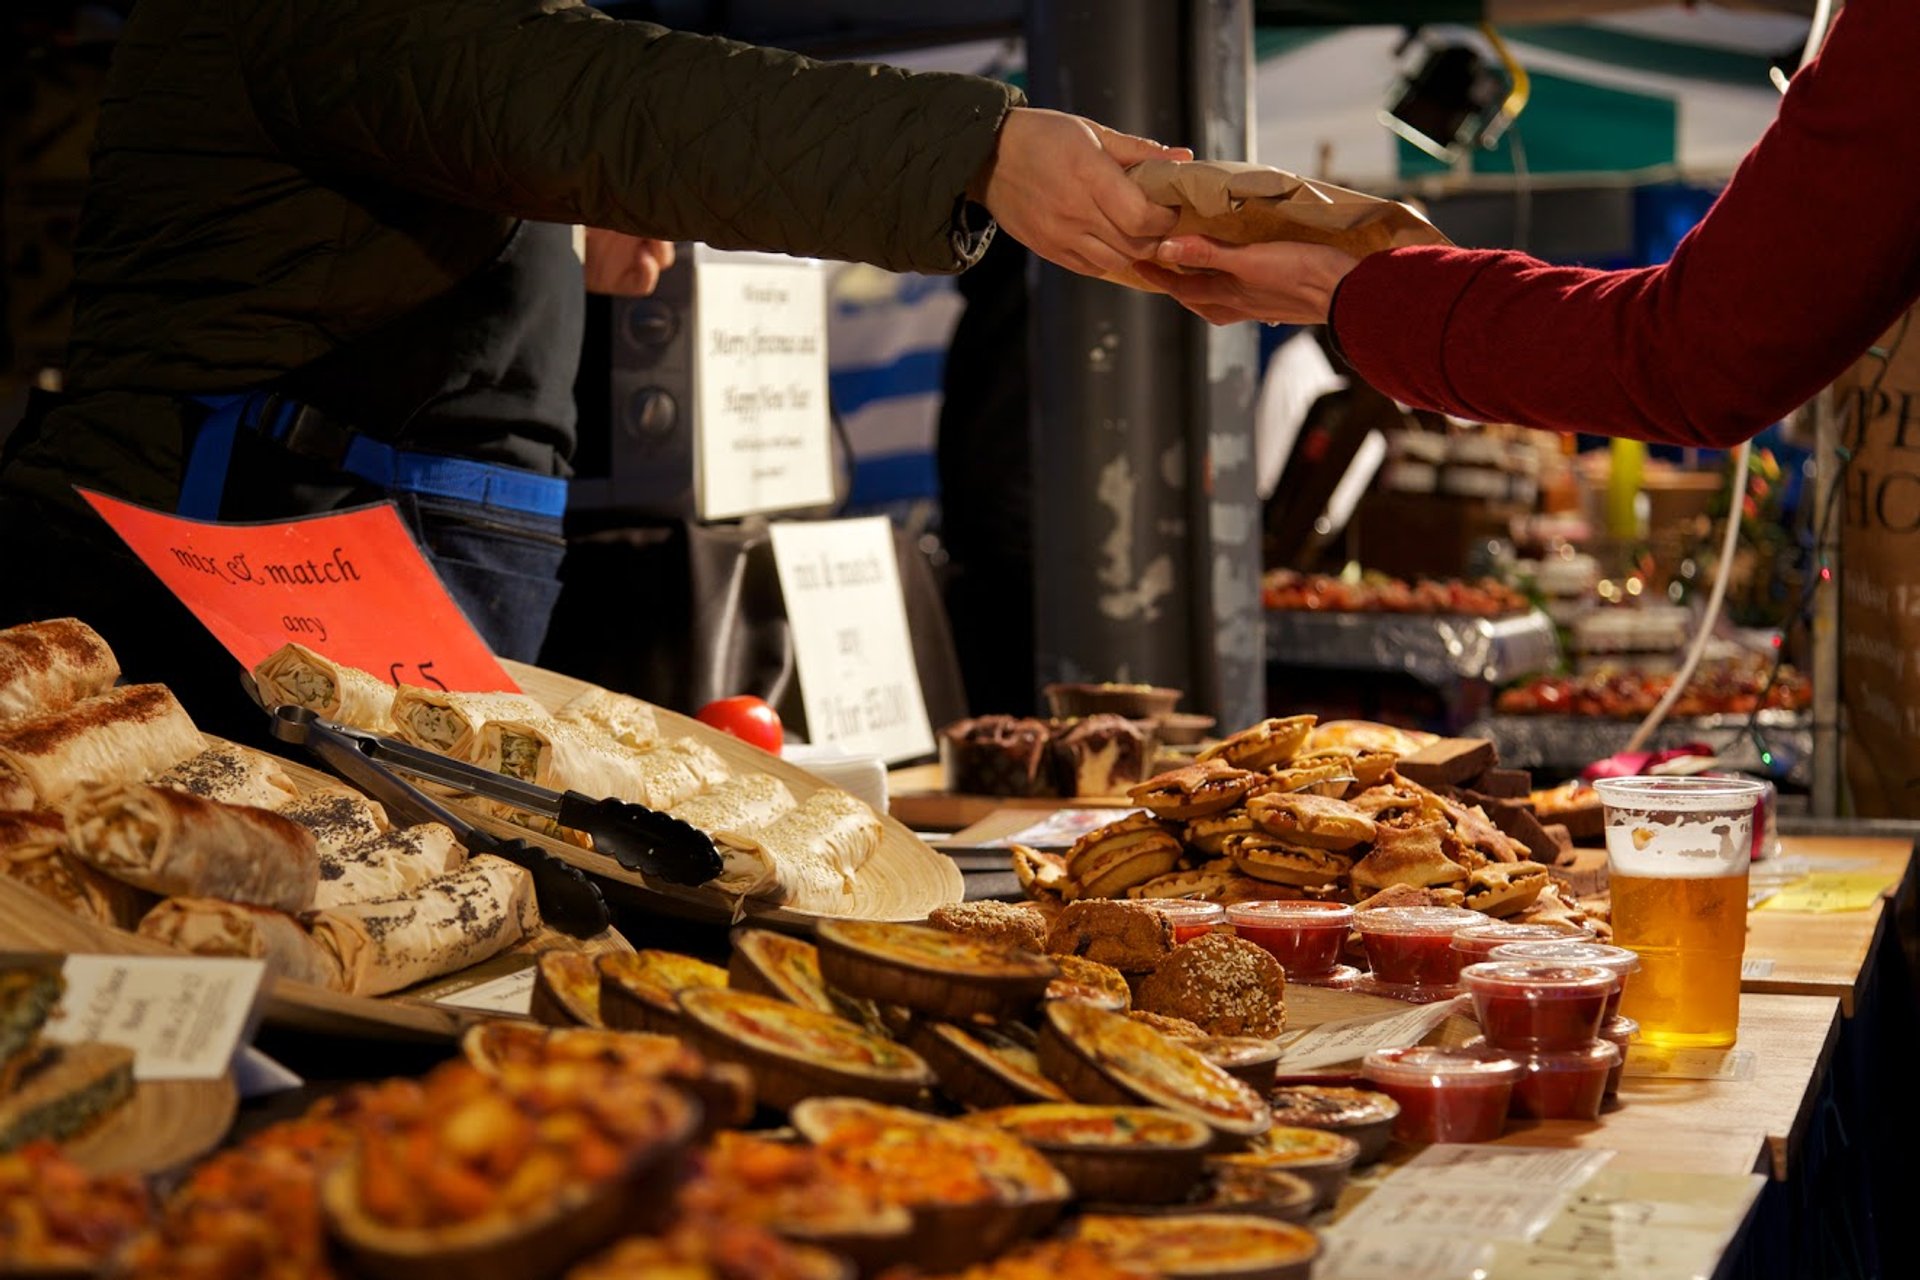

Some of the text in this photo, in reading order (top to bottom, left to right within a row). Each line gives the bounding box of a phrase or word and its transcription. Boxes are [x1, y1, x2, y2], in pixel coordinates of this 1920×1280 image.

[170, 546, 236, 585] mix
[264, 547, 360, 584] match
[282, 615, 327, 642] any
